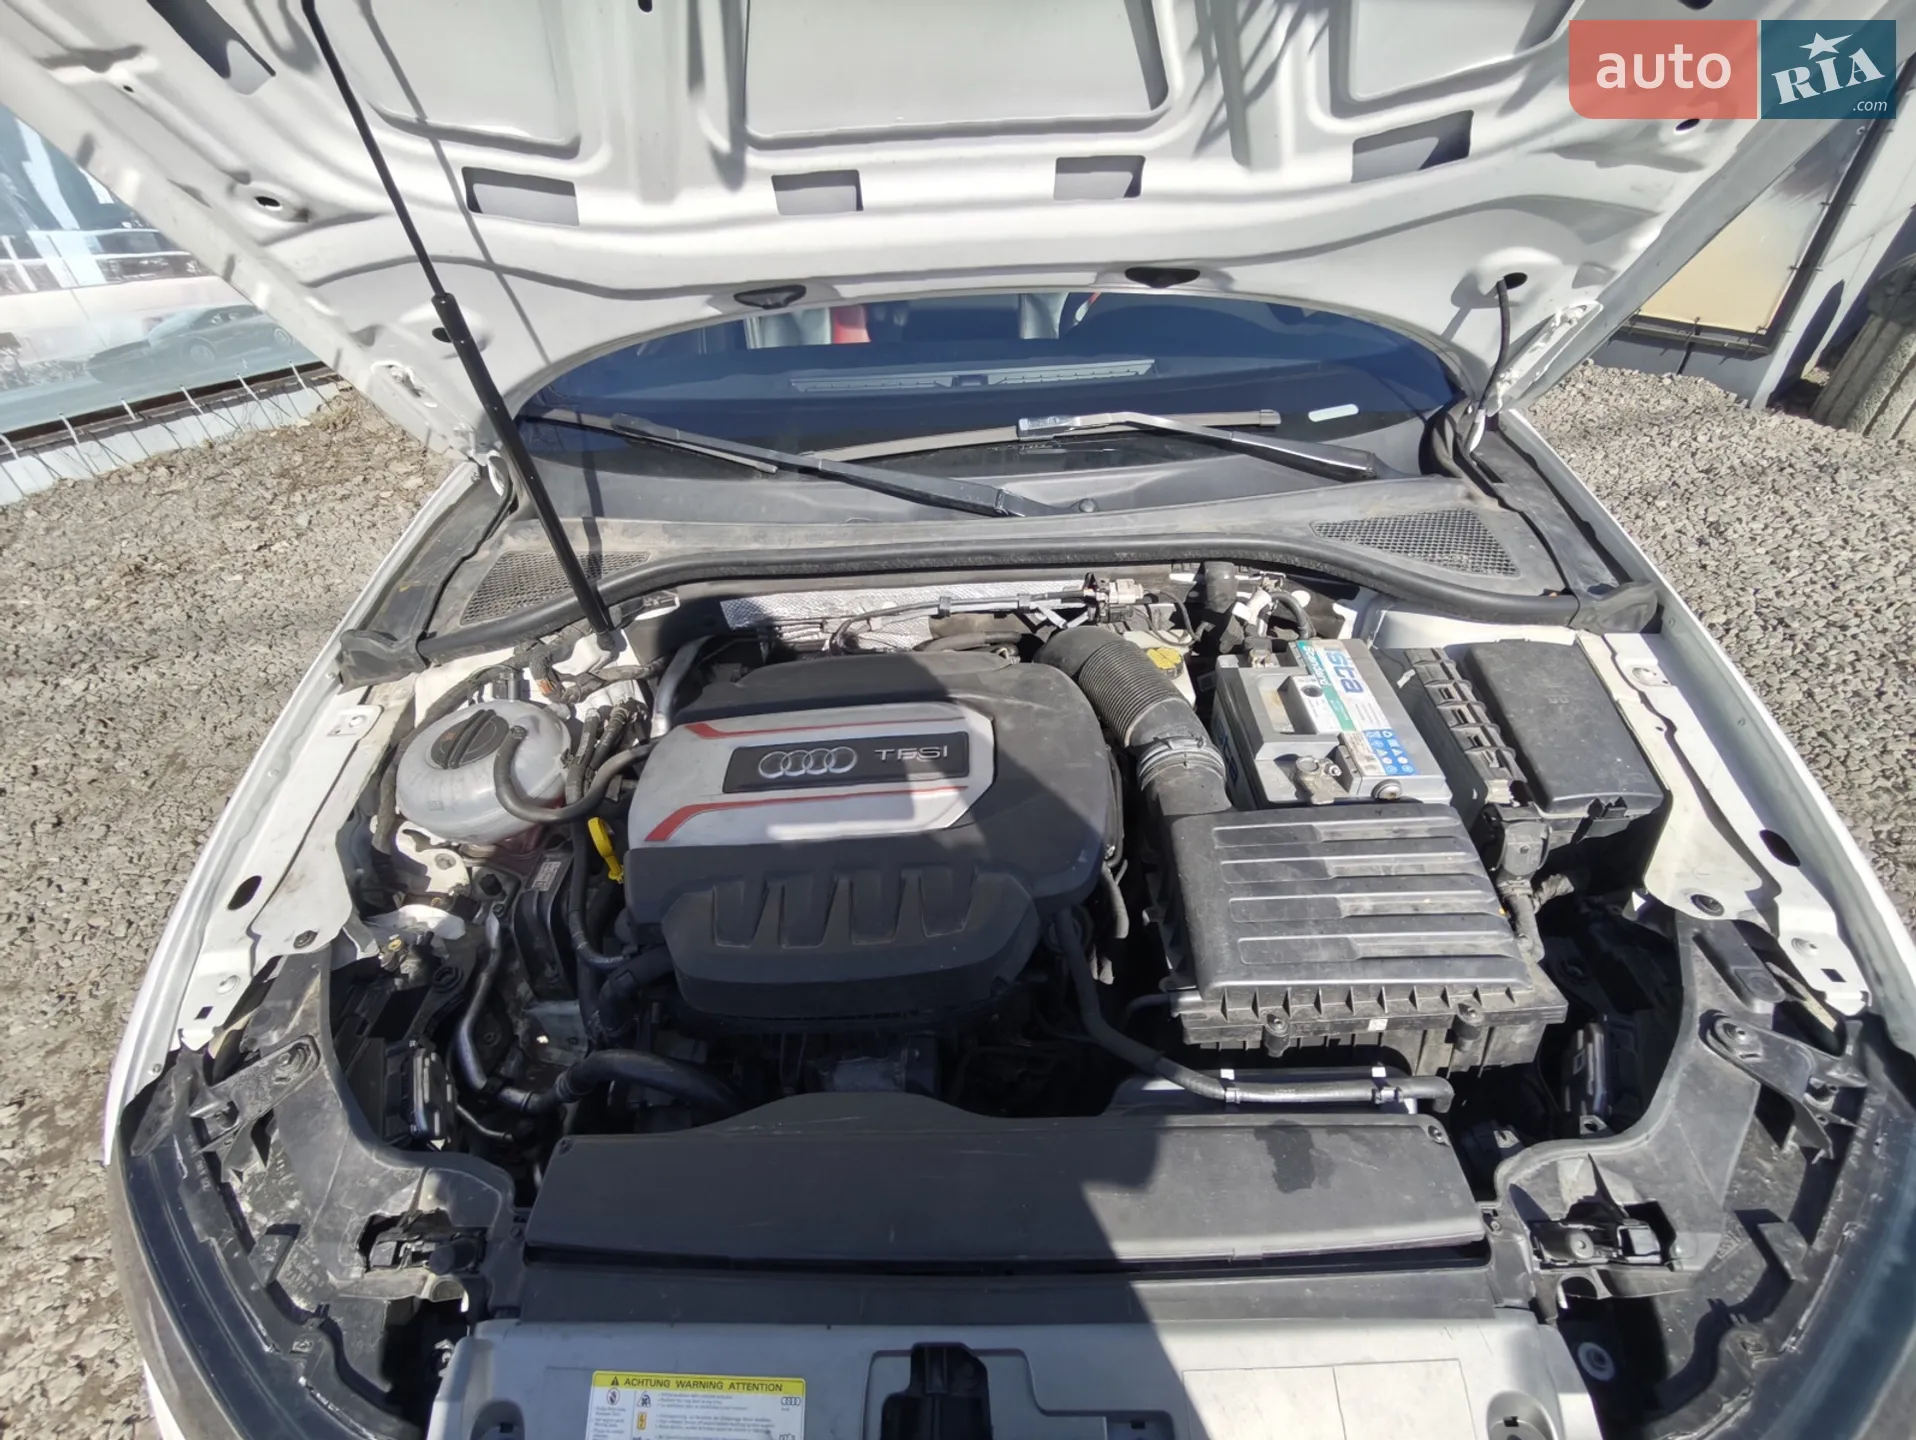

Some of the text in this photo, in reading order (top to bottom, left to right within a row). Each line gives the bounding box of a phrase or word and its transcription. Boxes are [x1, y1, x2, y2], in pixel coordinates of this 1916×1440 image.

[875, 744, 948, 762] TFSI
[623, 1379, 783, 1392] ACHTUNG WARNING ATTENTION
